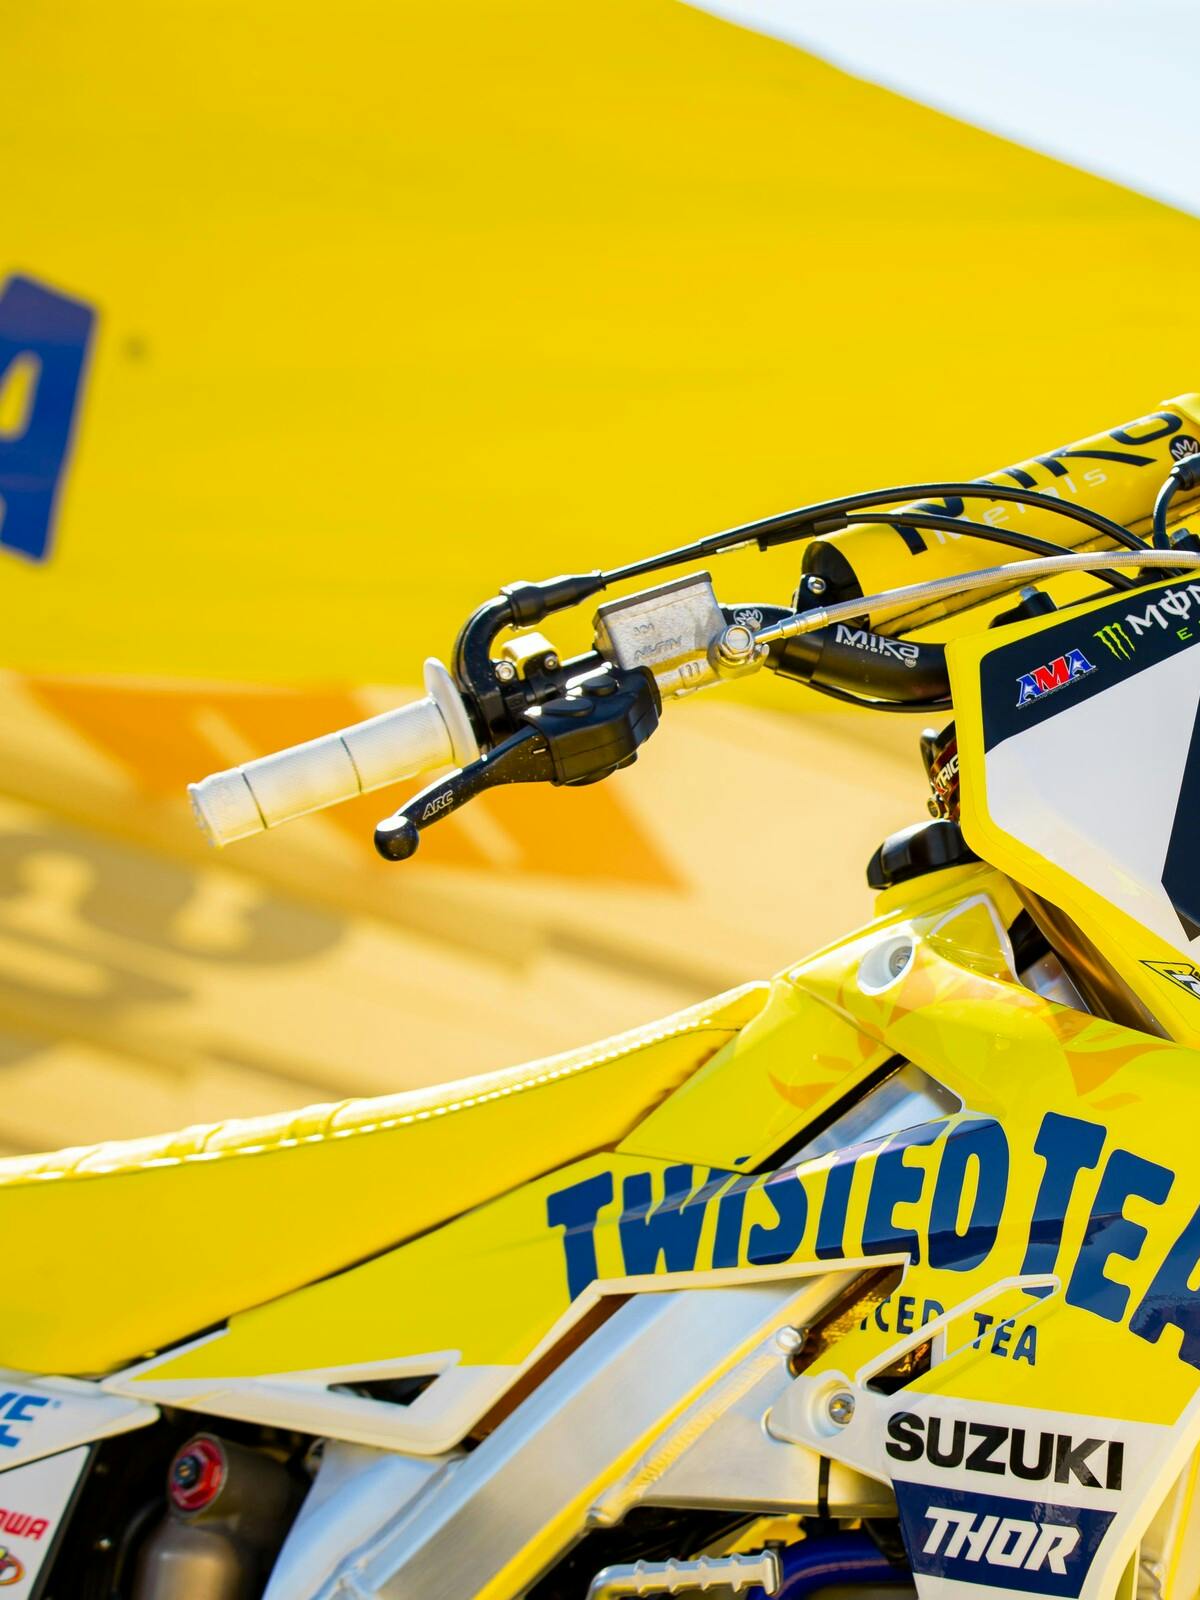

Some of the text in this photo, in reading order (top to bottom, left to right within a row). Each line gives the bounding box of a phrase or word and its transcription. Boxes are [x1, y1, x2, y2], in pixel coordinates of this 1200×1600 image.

[1015, 648, 1096, 707] AMA
[422, 790, 454, 820] ARC
[546, 1119, 1010, 1302] TWISTED
[973, 1312, 1037, 1366] TEA
[885, 1411, 1125, 1491] SUZUKI
[922, 1506, 1081, 1575] THOR
